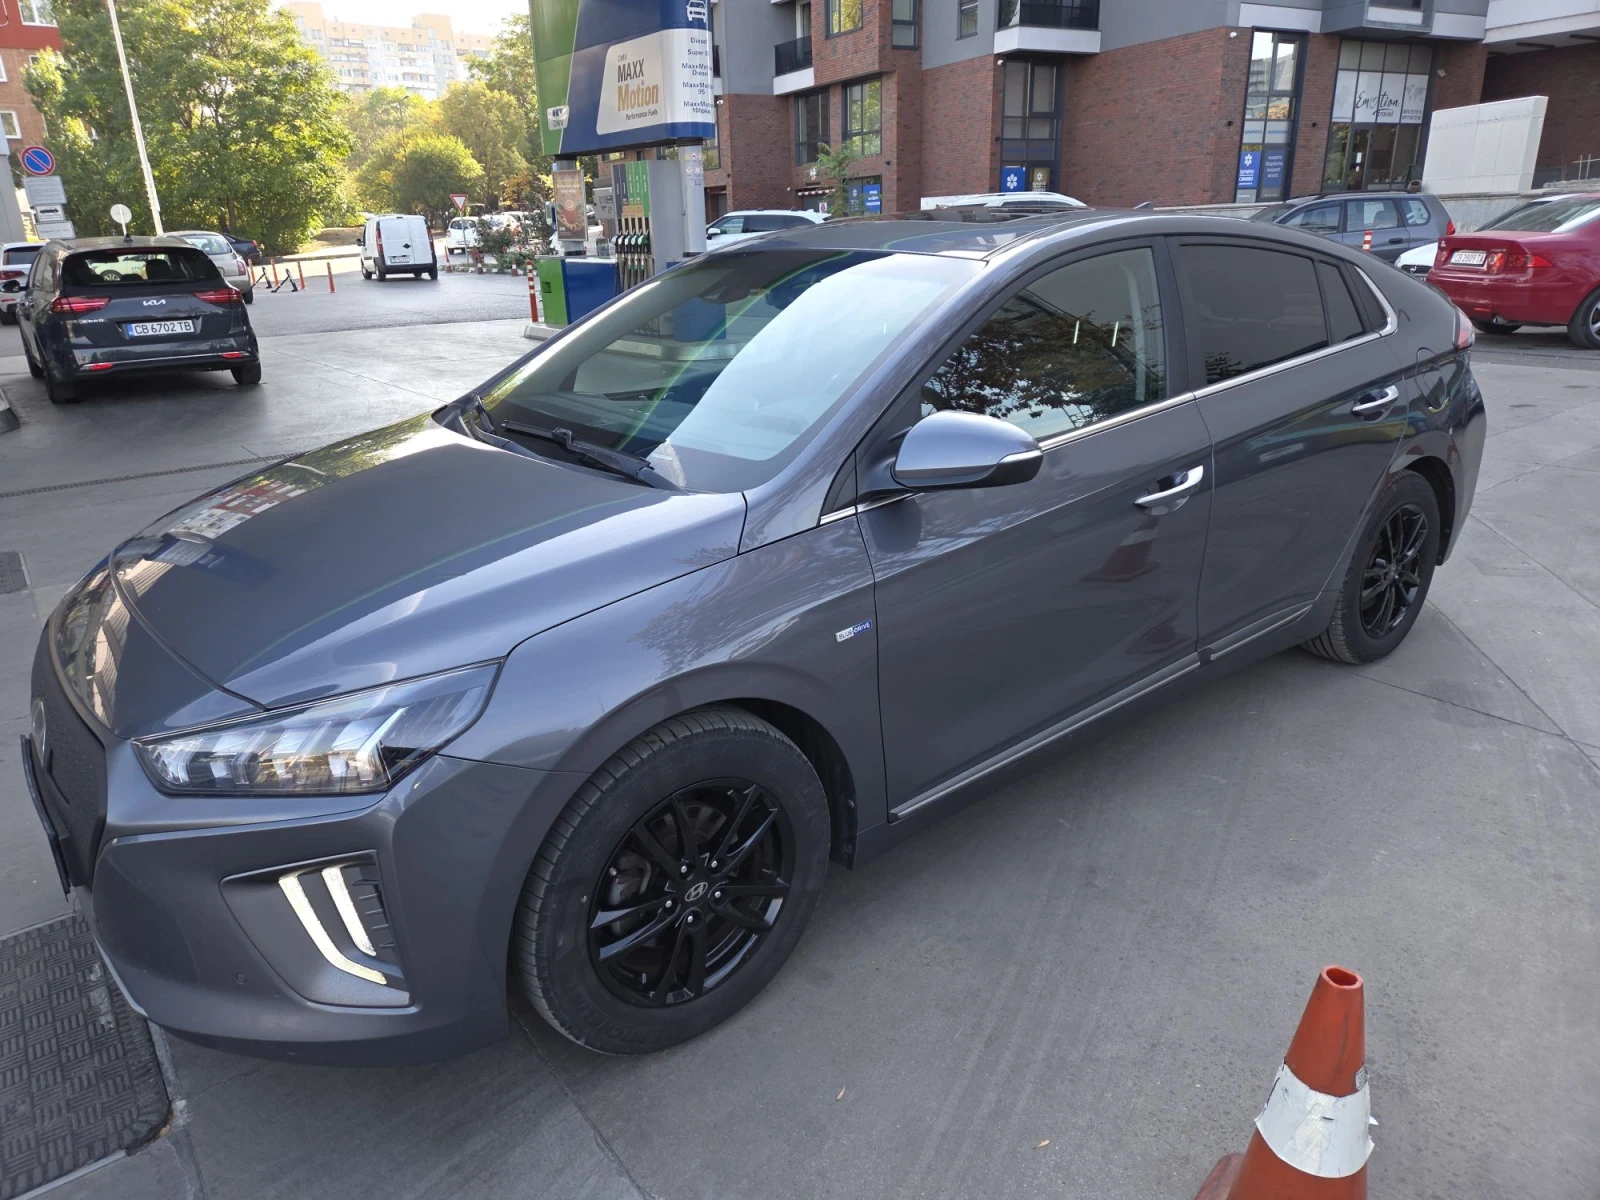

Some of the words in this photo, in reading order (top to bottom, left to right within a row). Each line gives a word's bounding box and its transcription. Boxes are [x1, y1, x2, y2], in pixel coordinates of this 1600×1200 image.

[687, 49, 704, 57] Super
[617, 59, 645, 83] MAXX
[617, 80, 659, 112] Motion
[1355, 90, 1400, 109] Emotion
[625, 111, 648, 121] Performance
[648, 109, 658, 117] Fuels
[1372, 108, 1394, 118] travel
[134, 324, 149, 335] CB
[151, 322, 177, 334] 6702
[177, 321, 192, 332] TB
